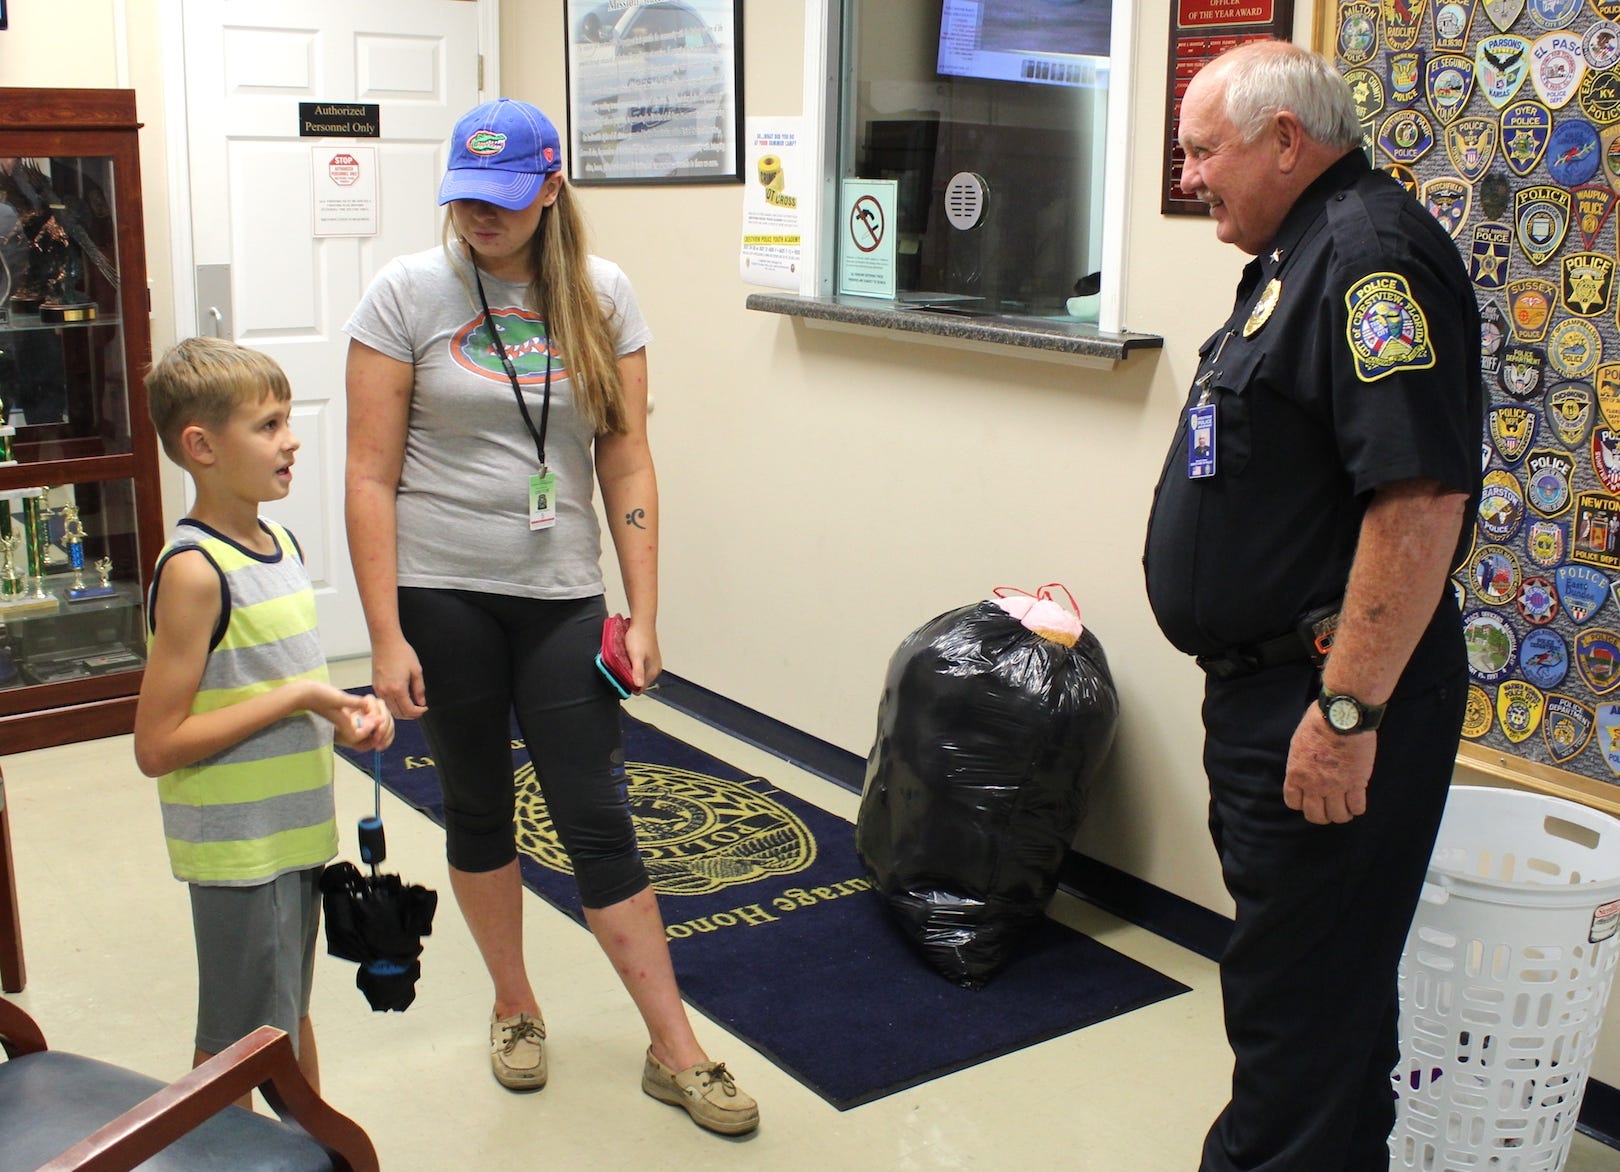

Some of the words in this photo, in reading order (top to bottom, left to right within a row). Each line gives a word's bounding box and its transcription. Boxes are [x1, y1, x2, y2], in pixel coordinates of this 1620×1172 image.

[1188, 11, 1198, 20] OF
[1199, 10, 1214, 20] THE
[1215, 9, 1234, 19] YEAR
[1235, 7, 1263, 18] AWARD
[1344, 4, 1377, 20] MILTON
[1598, 5, 1620, 15] POLIC
[1387, 27, 1416, 37] RADCLIFF
[1488, 39, 1522, 49] PARSONS
[1343, 50, 1367, 62] POLICE
[1533, 45, 1548, 59] EL
[1431, 62, 1441, 73] EL
[1441, 58, 1471, 72] SEGUNDO
[1368, 76, 1381, 103] COUNTY
[1391, 88, 1418, 102] POLICE
[1489, 88, 1510, 98] KANSAS
[1546, 90, 1566, 98] POLICE
[314, 105, 366, 116] Authorized
[1436, 102, 1457, 121] POLICE
[1515, 106, 1538, 116] DYER
[1586, 104, 1620, 121] POLIC
[304, 121, 350, 133] Personnel
[352, 122, 375, 135] Only
[1381, 112, 1416, 138] HUNTINGTON
[1415, 117, 1432, 138] PARK
[1459, 121, 1484, 131] POLICE
[1510, 117, 1541, 125] POLICE
[1394, 149, 1418, 157] POLICE
[335, 156, 353, 165] STOP
[775, 193, 797, 208] CROSS
[1519, 189, 1568, 205] POLICE
[1579, 201, 1604, 215] POLICE
[1476, 231, 1509, 243] POLICE
[1566, 256, 1612, 273] POLICE
[1356, 278, 1398, 299] POLICE
[1511, 282, 1553, 296] SUSSEX
[1354, 340, 1371, 358] CITY
[1404, 301, 1424, 343] FLORIDA
[1505, 354, 1541, 365] DEPARTMENT
[1513, 349, 1534, 359] POLICE
[1562, 354, 1584, 363] POLICE
[1498, 408, 1527, 418] POLICE
[1530, 456, 1571, 476] POLICE
[1482, 487, 1519, 506] BARSTOW
[1580, 496, 1620, 512] NEWTON
[1484, 521, 1509, 534] POLICE
[1575, 550, 1599, 561] POLICE
[1600, 554, 1619, 565] DEPT
[1559, 567, 1609, 589] POLICE
[1590, 633, 1617, 646] POLICE
[1504, 690, 1522, 699] POLICE
[1559, 698, 1583, 714] POLICE
[1548, 704, 1591, 728] DEPARTMENT
[651, 823, 756, 858] POLIC
[772, 877, 871, 911] urage
[665, 903, 781, 942] Hono
